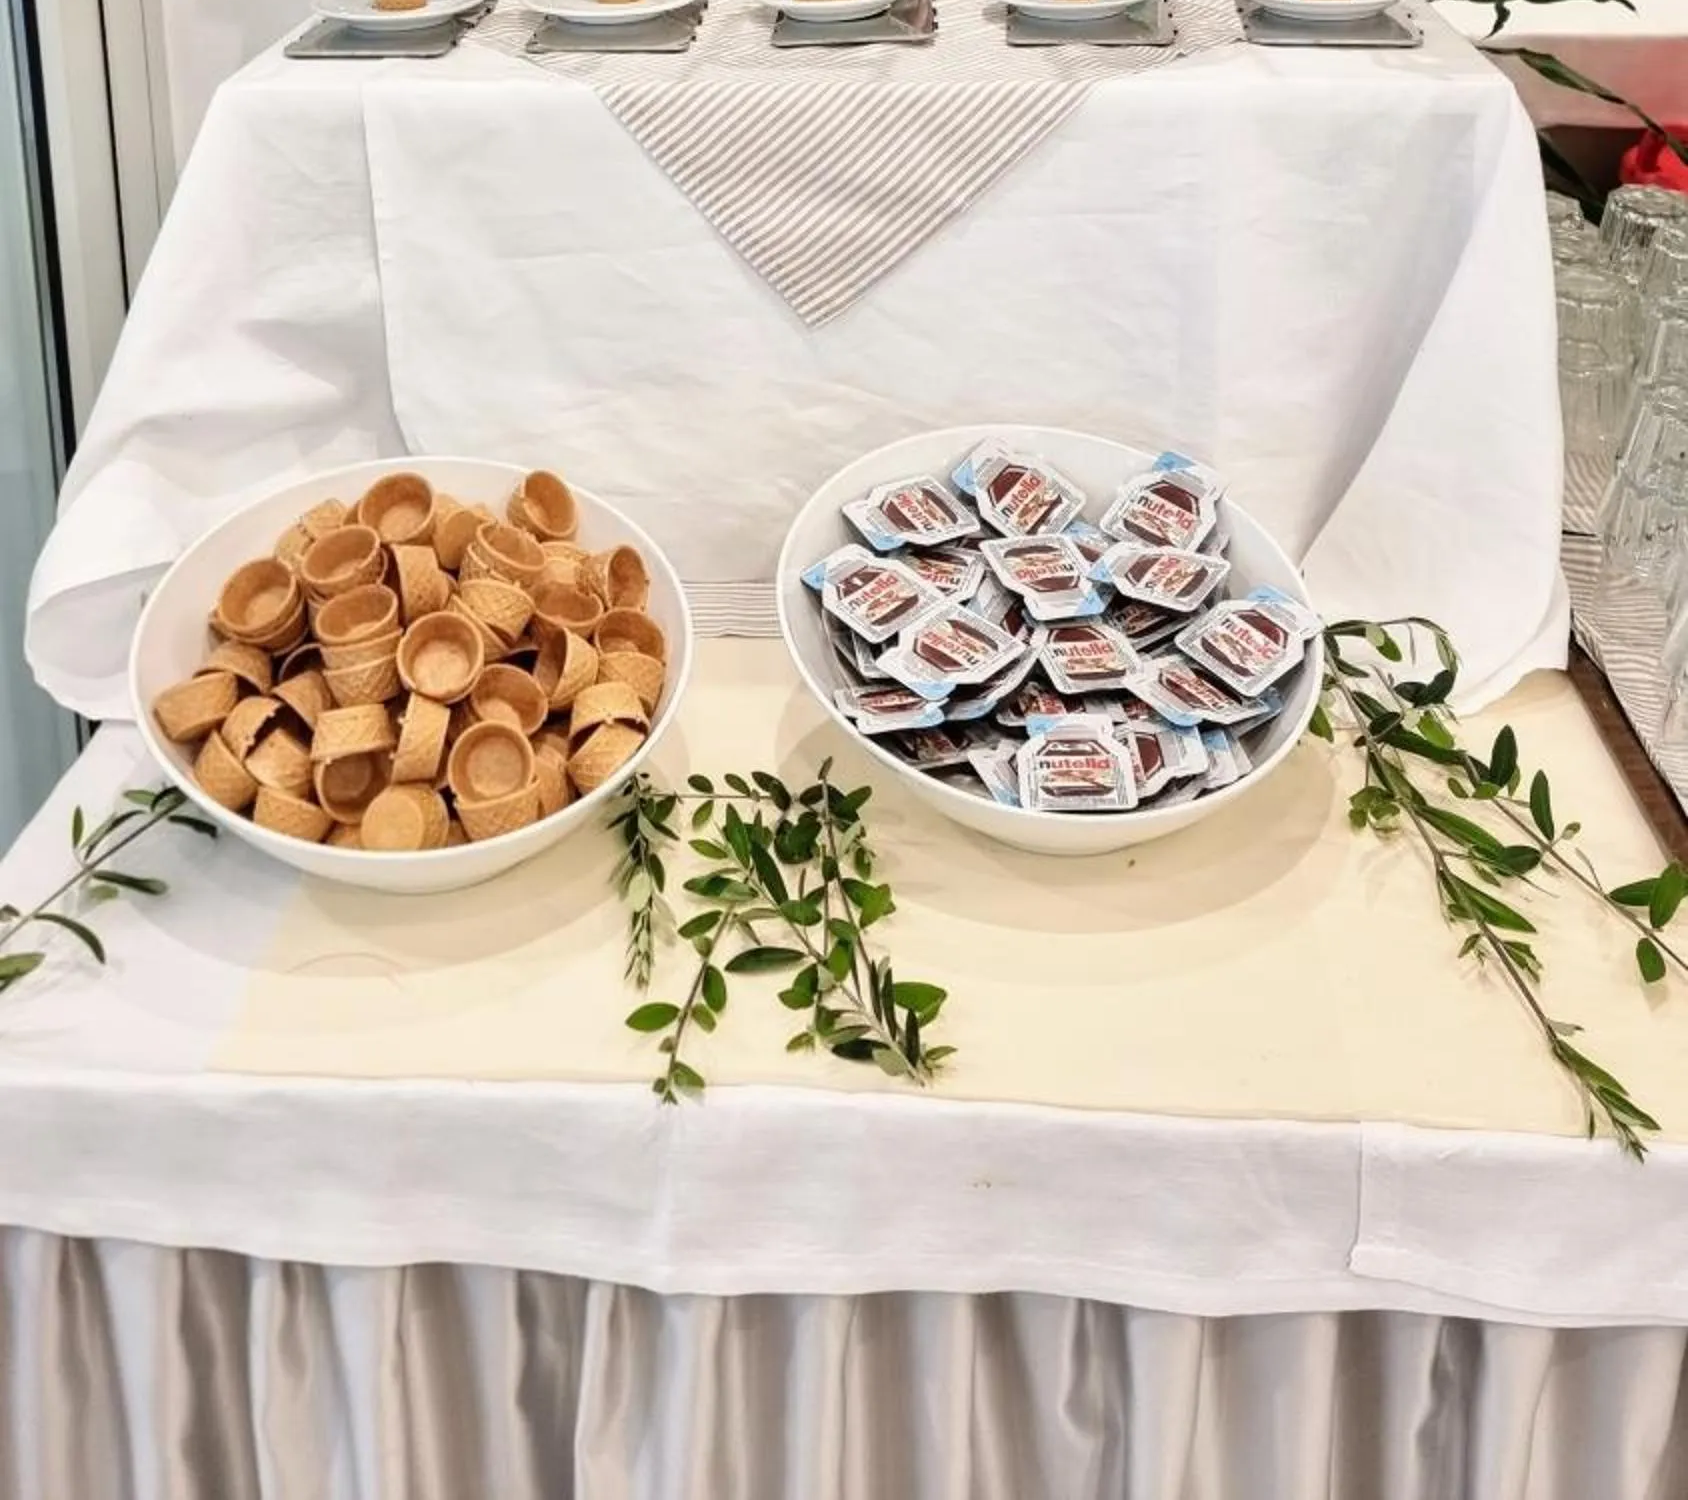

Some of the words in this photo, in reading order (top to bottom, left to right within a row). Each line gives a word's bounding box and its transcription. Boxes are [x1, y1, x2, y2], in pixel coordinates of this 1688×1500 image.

[1000, 474, 1042, 519] nutella
[897, 492, 935, 532] nutella
[1136, 494, 1193, 531] nutella
[1014, 562, 1075, 581] nutella
[1052, 642, 1115, 658] nutella
[1039, 758, 1111, 770] nutella
